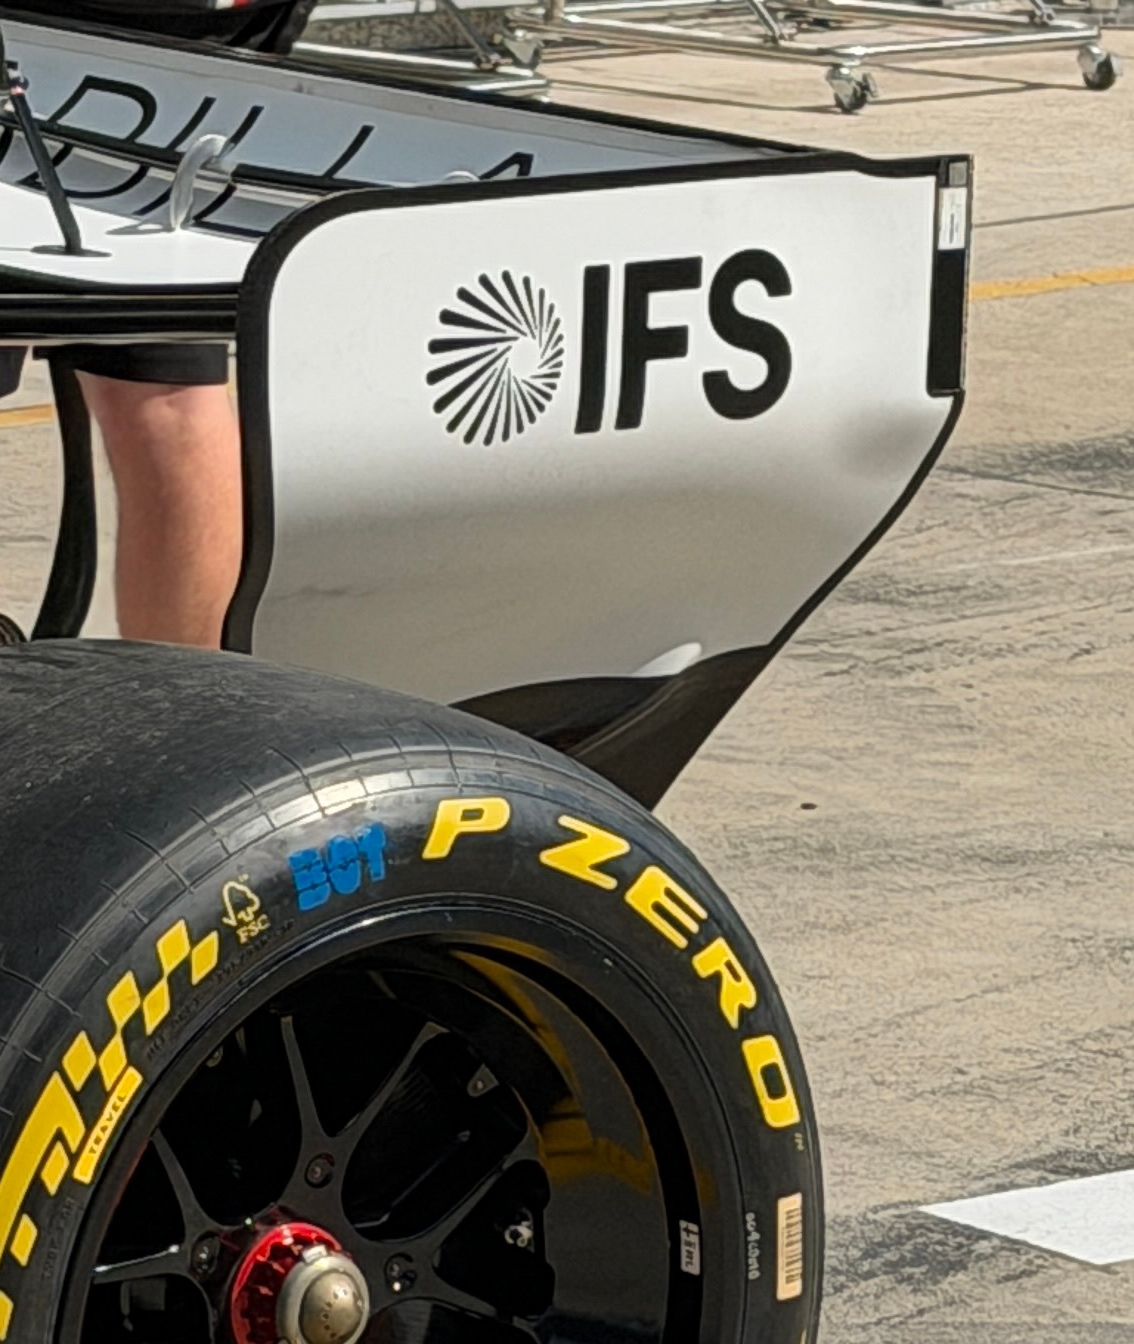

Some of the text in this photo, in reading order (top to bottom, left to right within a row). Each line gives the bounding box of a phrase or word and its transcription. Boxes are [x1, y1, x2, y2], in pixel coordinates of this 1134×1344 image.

[574, 248, 793, 435] IFS
[236, 915, 270, 945] FSC
[421, 796, 802, 1129] P ZERO
[89, 1094, 127, 1156] TRAVEL
